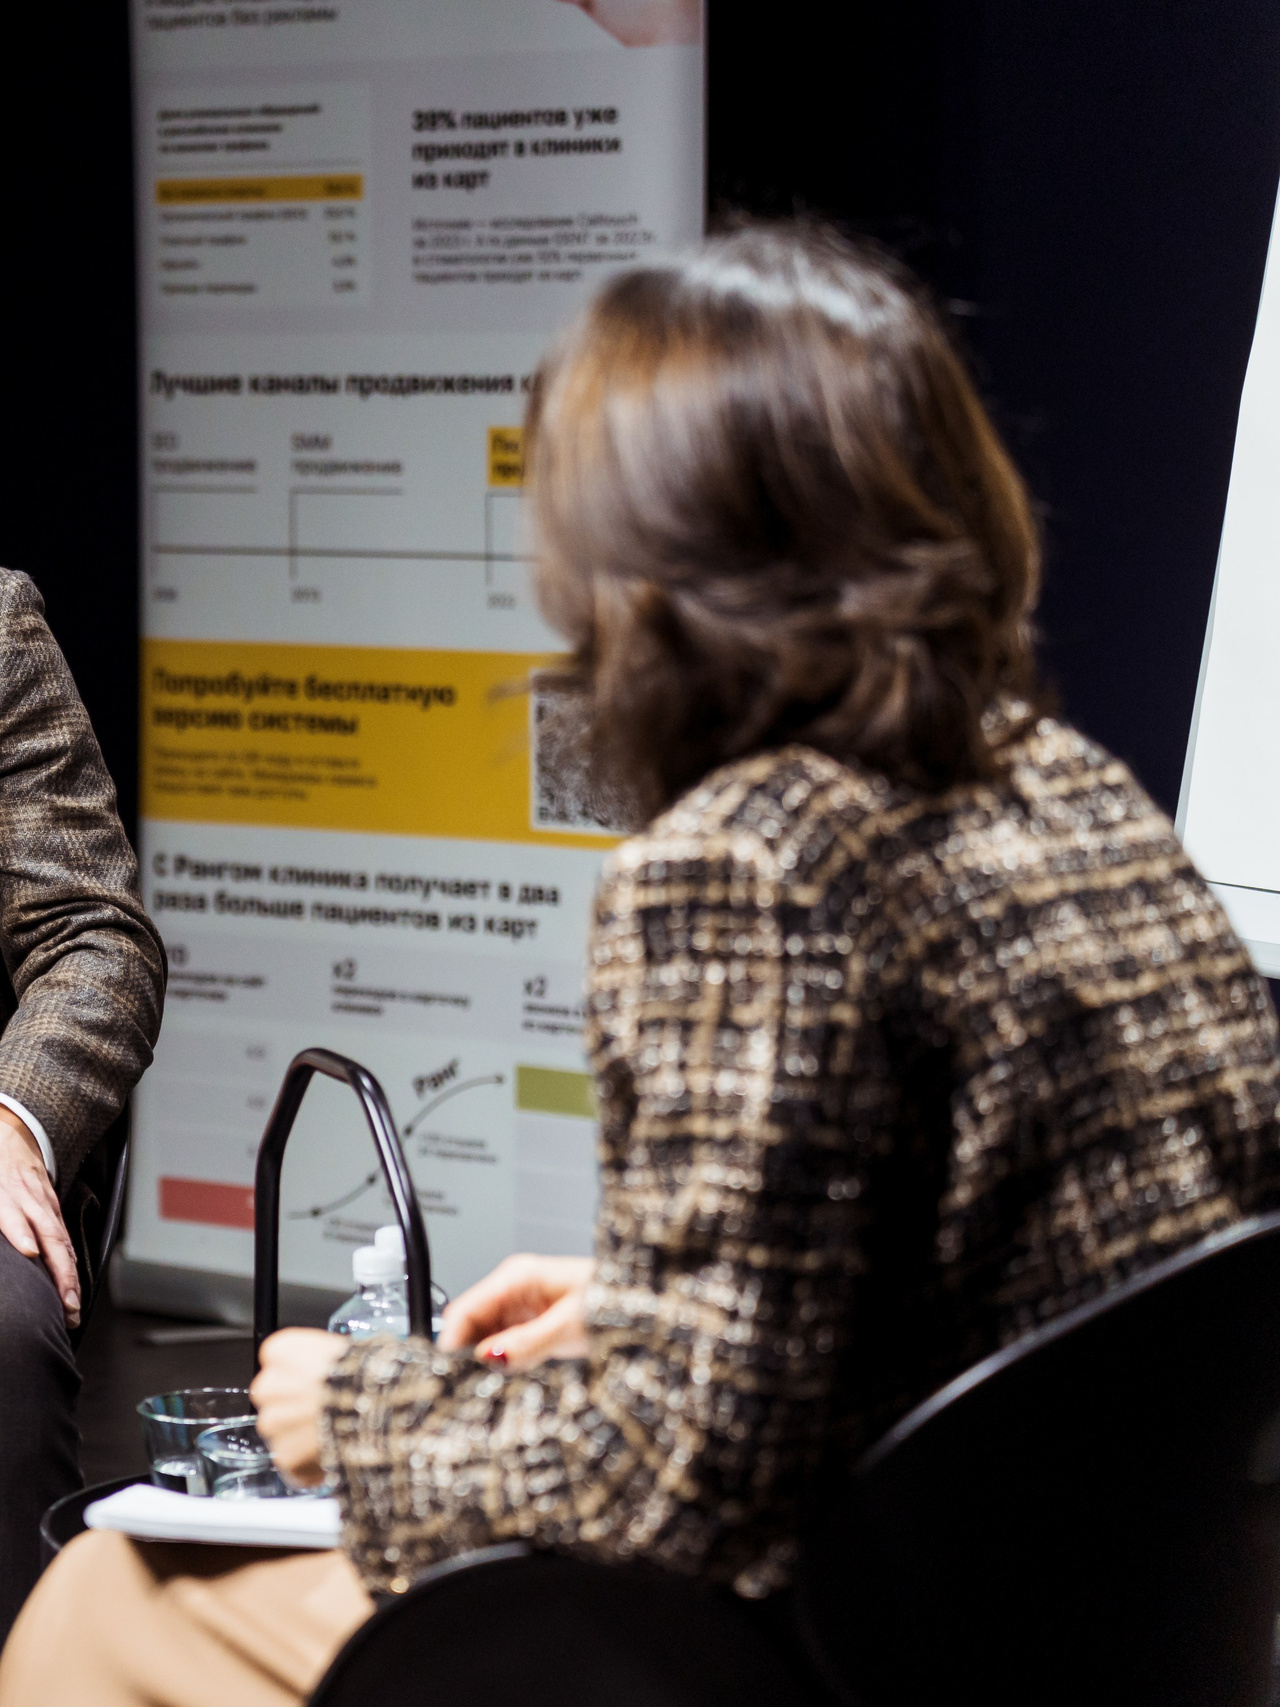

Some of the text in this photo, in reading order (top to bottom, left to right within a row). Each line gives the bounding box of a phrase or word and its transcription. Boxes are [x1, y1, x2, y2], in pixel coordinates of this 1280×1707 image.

[460, 109, 568, 131] пациентов
[573, 107, 618, 129] уже
[411, 138, 621, 163] приходят в клиники
[412, 170, 490, 191] из карт
[146, 369, 243, 400] Лучшие
[248, 375, 340, 395] каналы
[344, 374, 515, 399] продвижения
[151, 666, 456, 710] Попробуйте бесплатную
[152, 708, 358, 735] версию системы
[152, 852, 560, 905] С Рангом клиника получает в два
[152, 889, 538, 940] раза больше пациентов из карт
